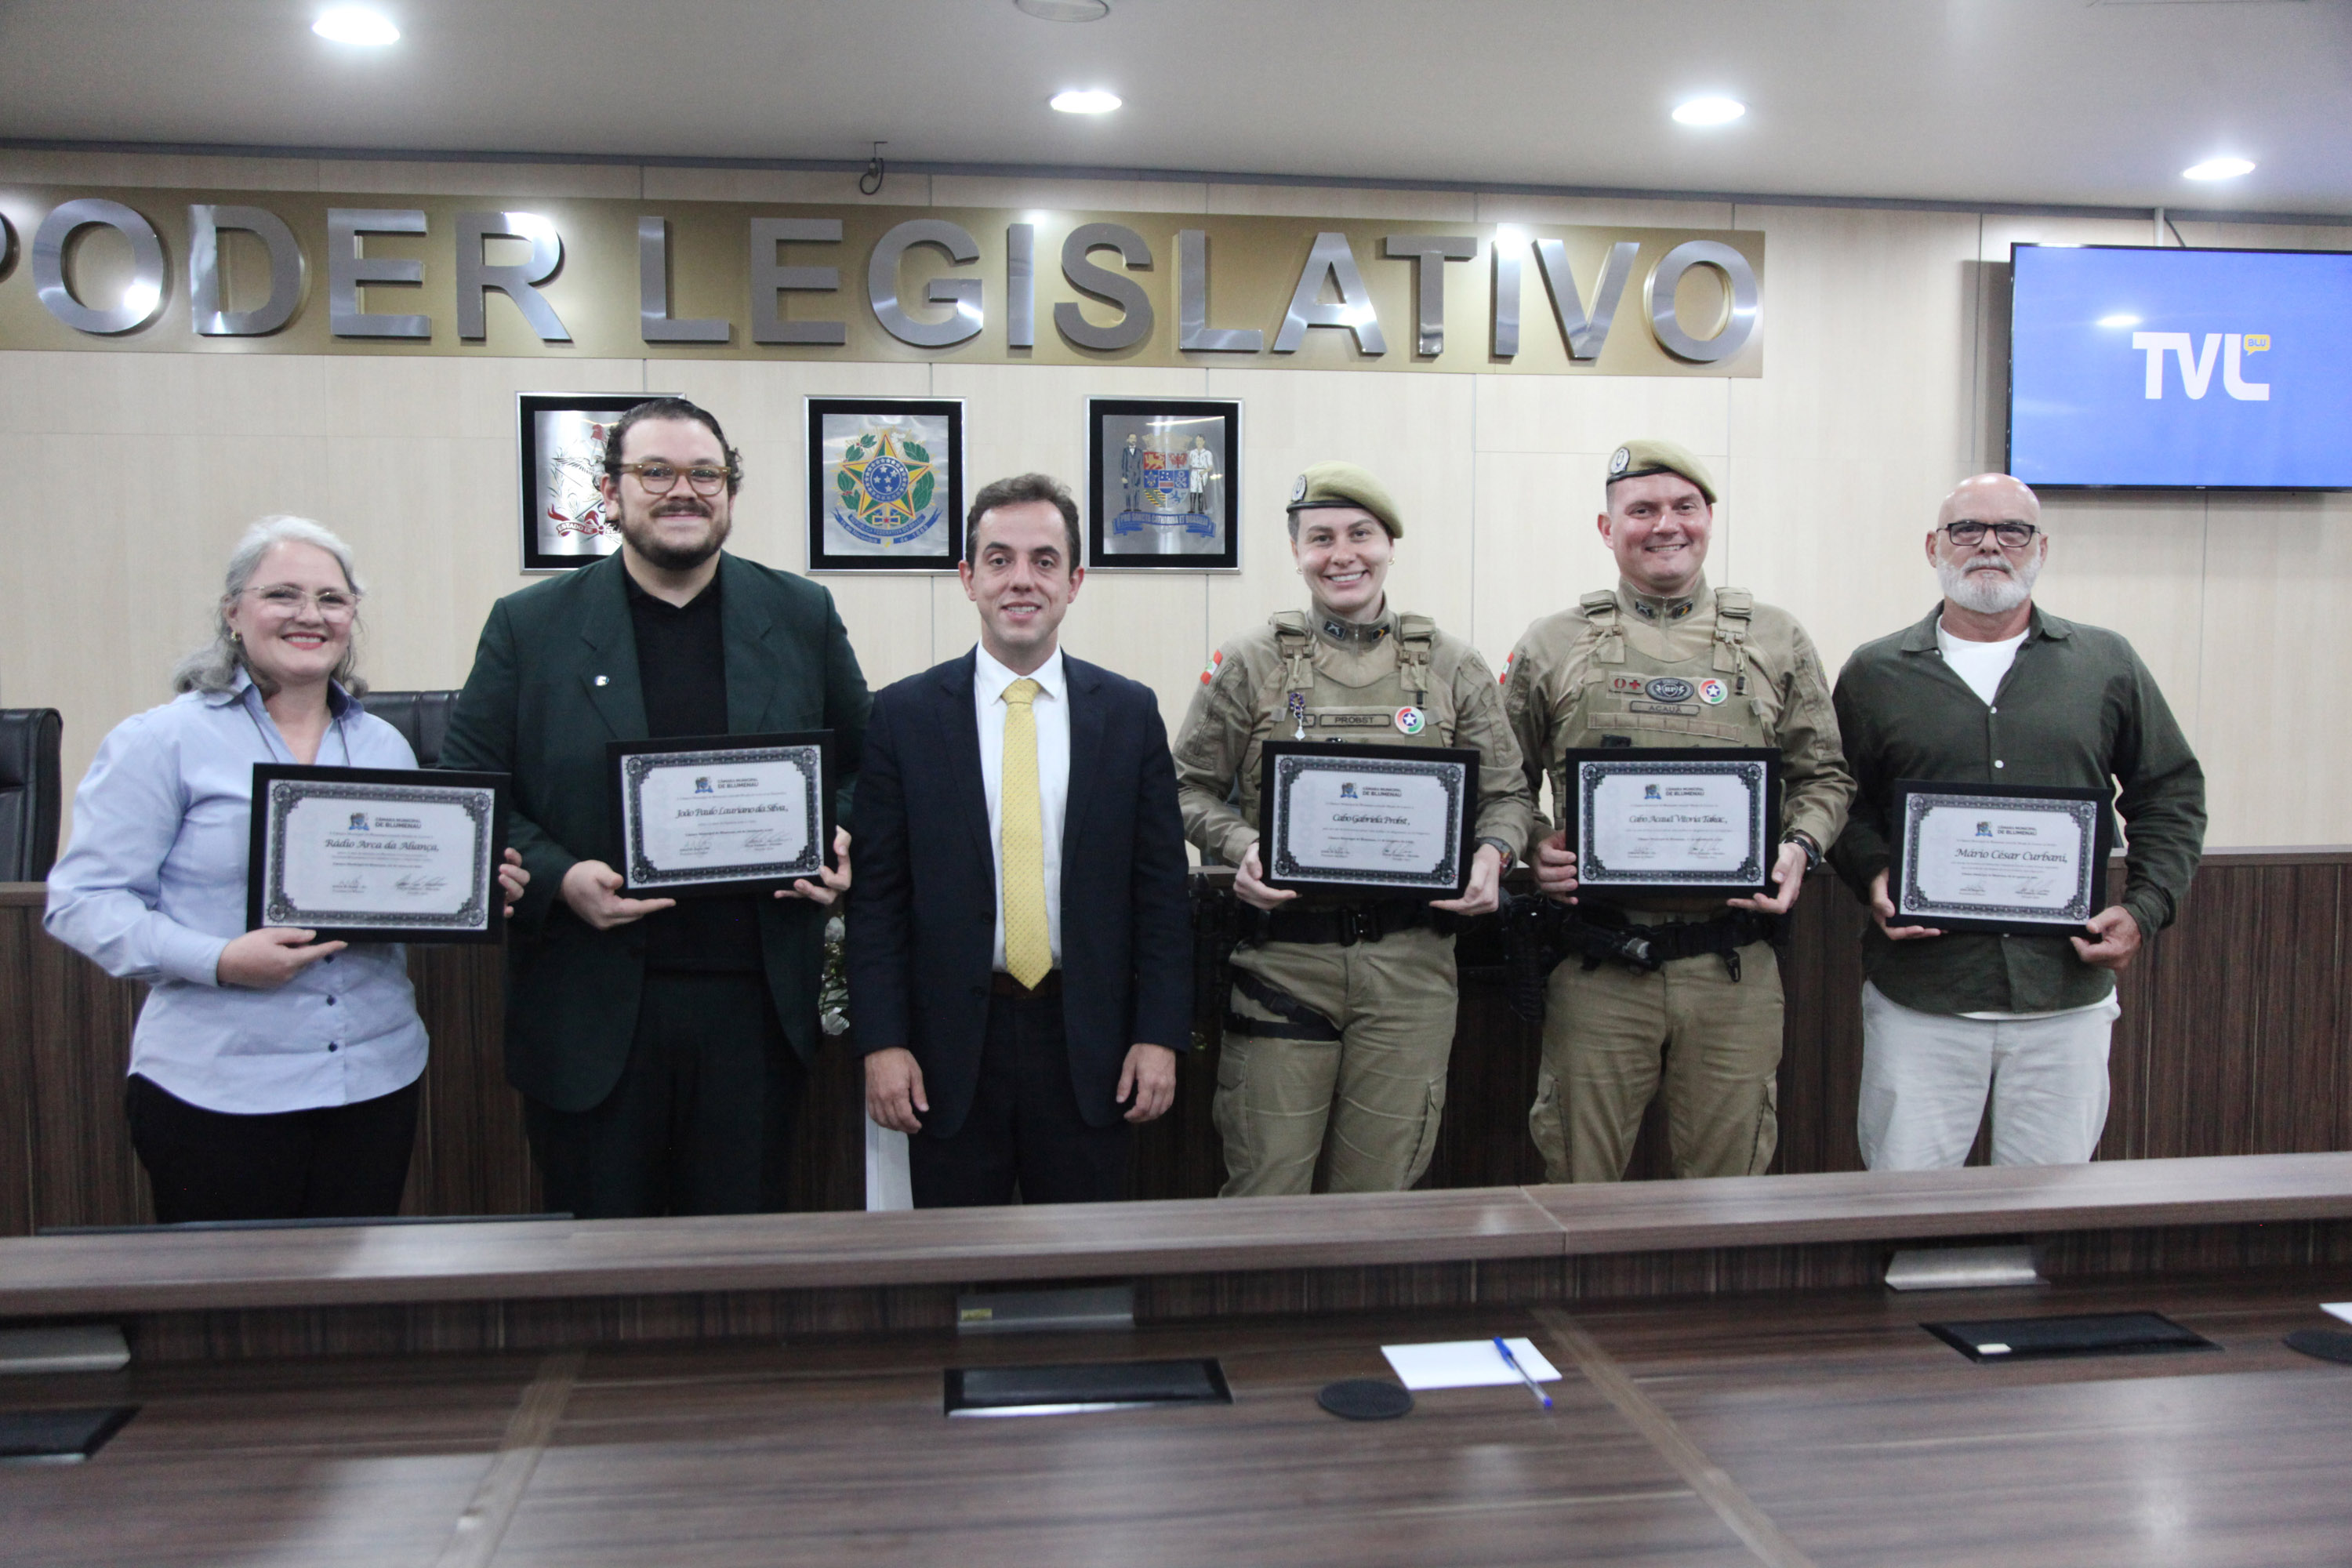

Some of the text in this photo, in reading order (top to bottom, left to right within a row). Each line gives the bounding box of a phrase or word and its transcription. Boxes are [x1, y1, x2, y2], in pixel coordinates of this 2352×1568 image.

[0, 198, 1758, 361] ODER LEGISLATIVO
[2248, 338, 2267, 347] BLU
[2132, 332, 2270, 401] TVL
[557, 521, 584, 532] ESTADO
[695, 806, 718, 816] Paulo
[755, 804, 765, 813] da
[325, 839, 440, 852] Rádio Arca da Aliança,
[1955, 848, 1989, 858] Mário
[1991, 849, 2020, 860] César
